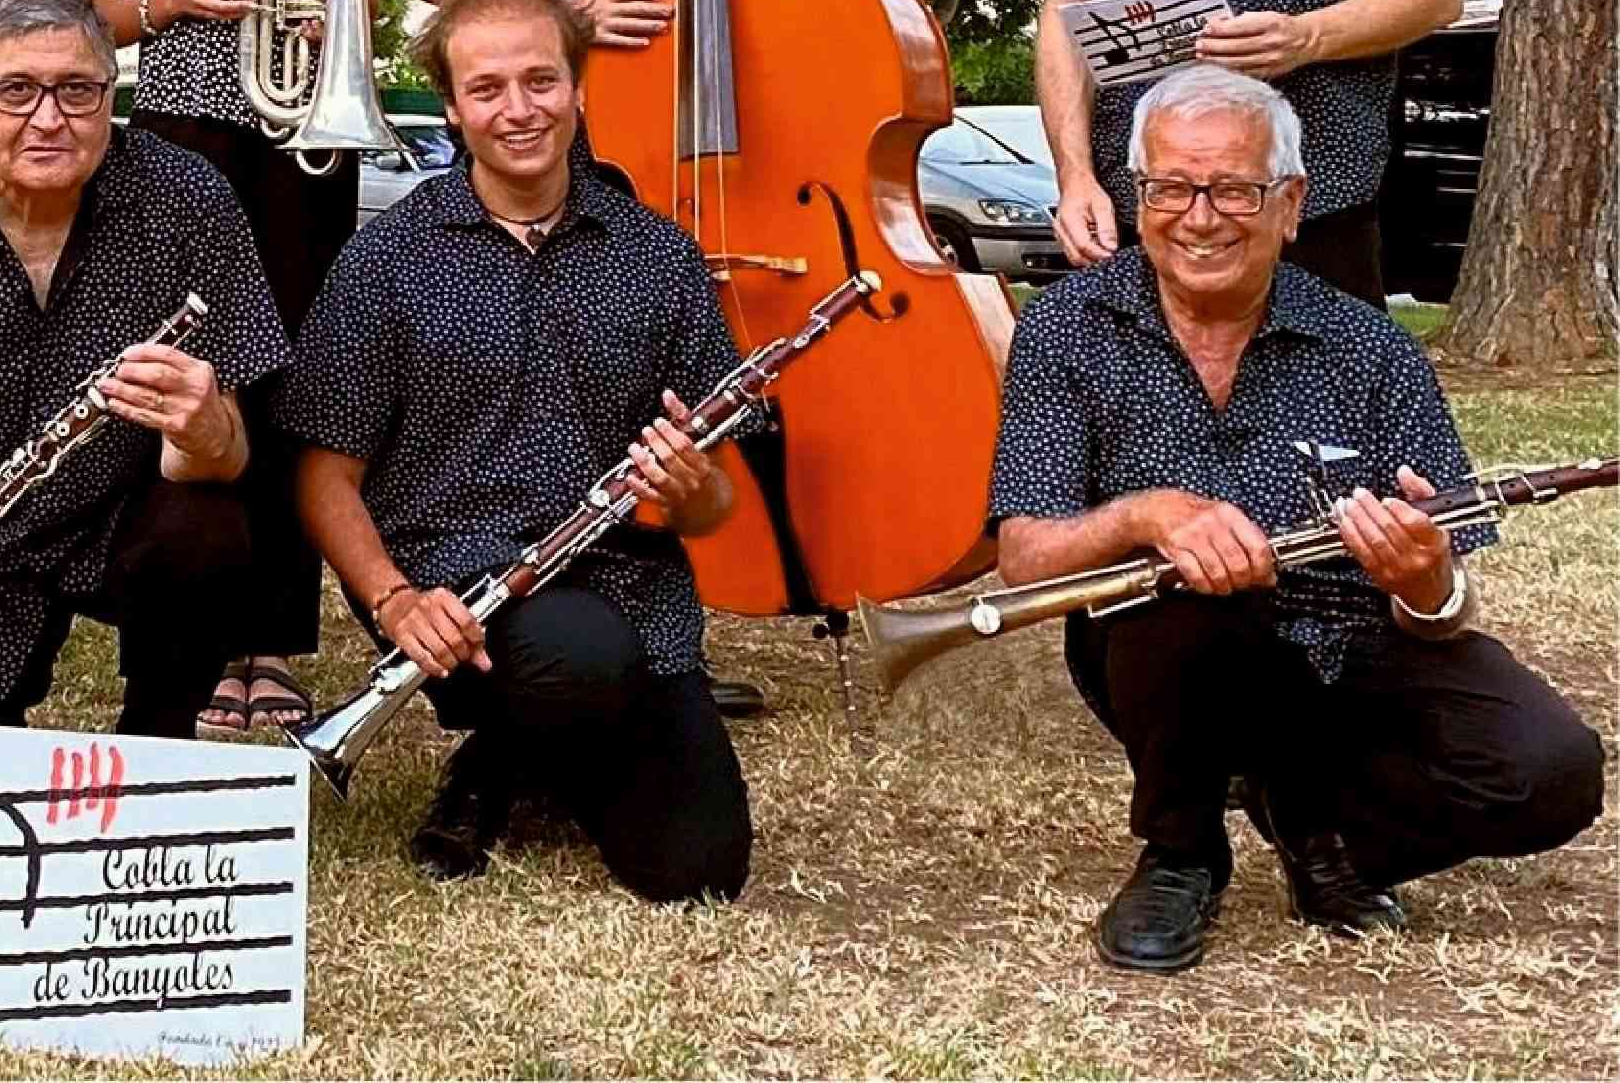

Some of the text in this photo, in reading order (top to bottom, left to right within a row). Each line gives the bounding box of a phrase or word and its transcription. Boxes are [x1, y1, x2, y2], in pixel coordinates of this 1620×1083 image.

[103, 843, 237, 889] Cobla la
[83, 896, 236, 944] Principal
[34, 951, 233, 1008] de Banyoles
